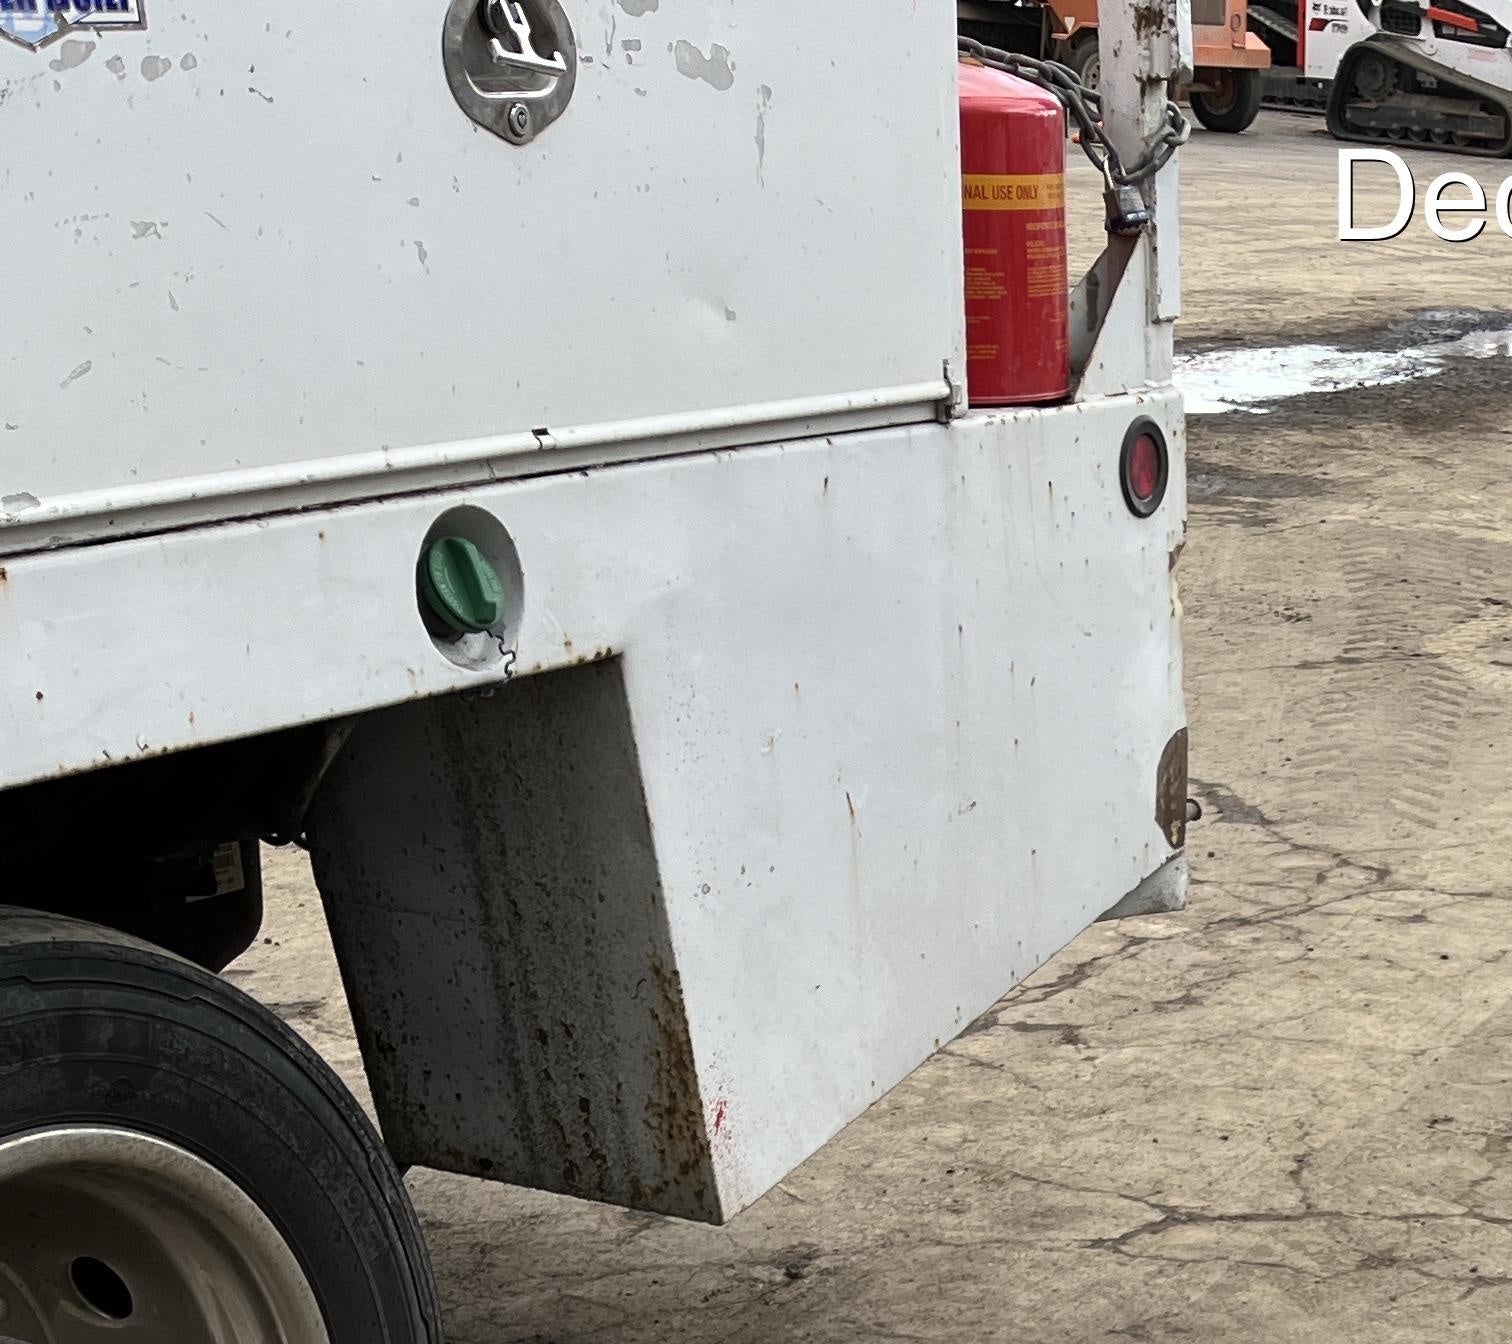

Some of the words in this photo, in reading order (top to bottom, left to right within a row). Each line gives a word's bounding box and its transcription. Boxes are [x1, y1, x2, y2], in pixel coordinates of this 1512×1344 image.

[964, 184, 989, 200] NAL
[992, 184, 1013, 200] USE
[1016, 183, 1039, 200] ONLY
